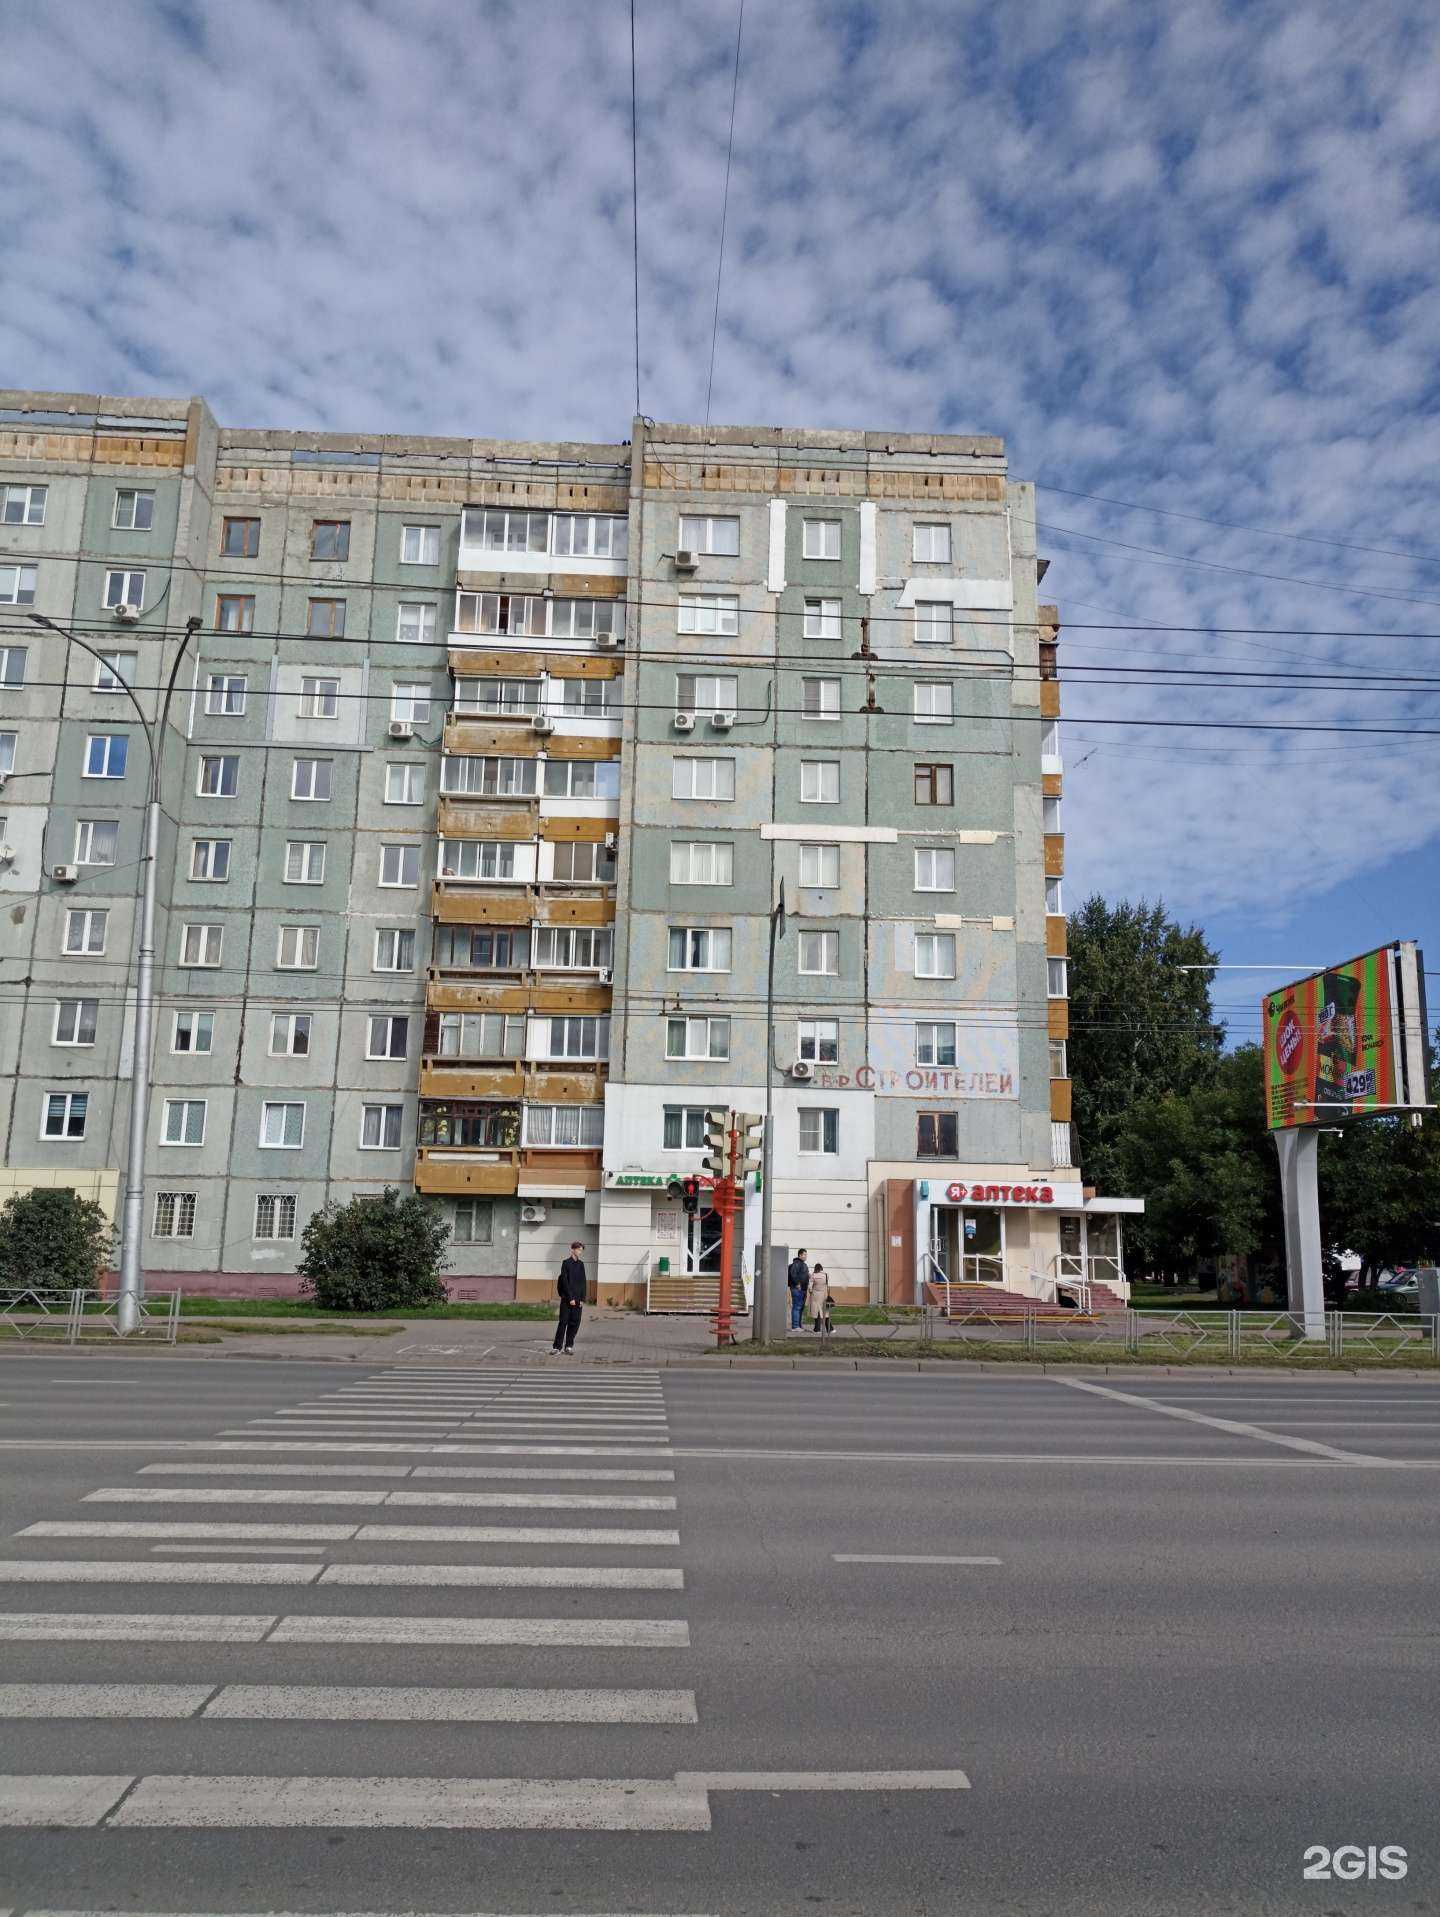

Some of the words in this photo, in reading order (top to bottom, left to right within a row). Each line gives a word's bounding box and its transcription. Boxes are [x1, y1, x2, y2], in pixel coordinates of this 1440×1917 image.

[855, 1065, 1013, 1094] СТРОИТЕЛЕЙ
[1346, 1074, 1366, 1094] 429
[615, 1175, 663, 1187] АПТЕКА
[971, 1184, 1055, 1204] аптека
